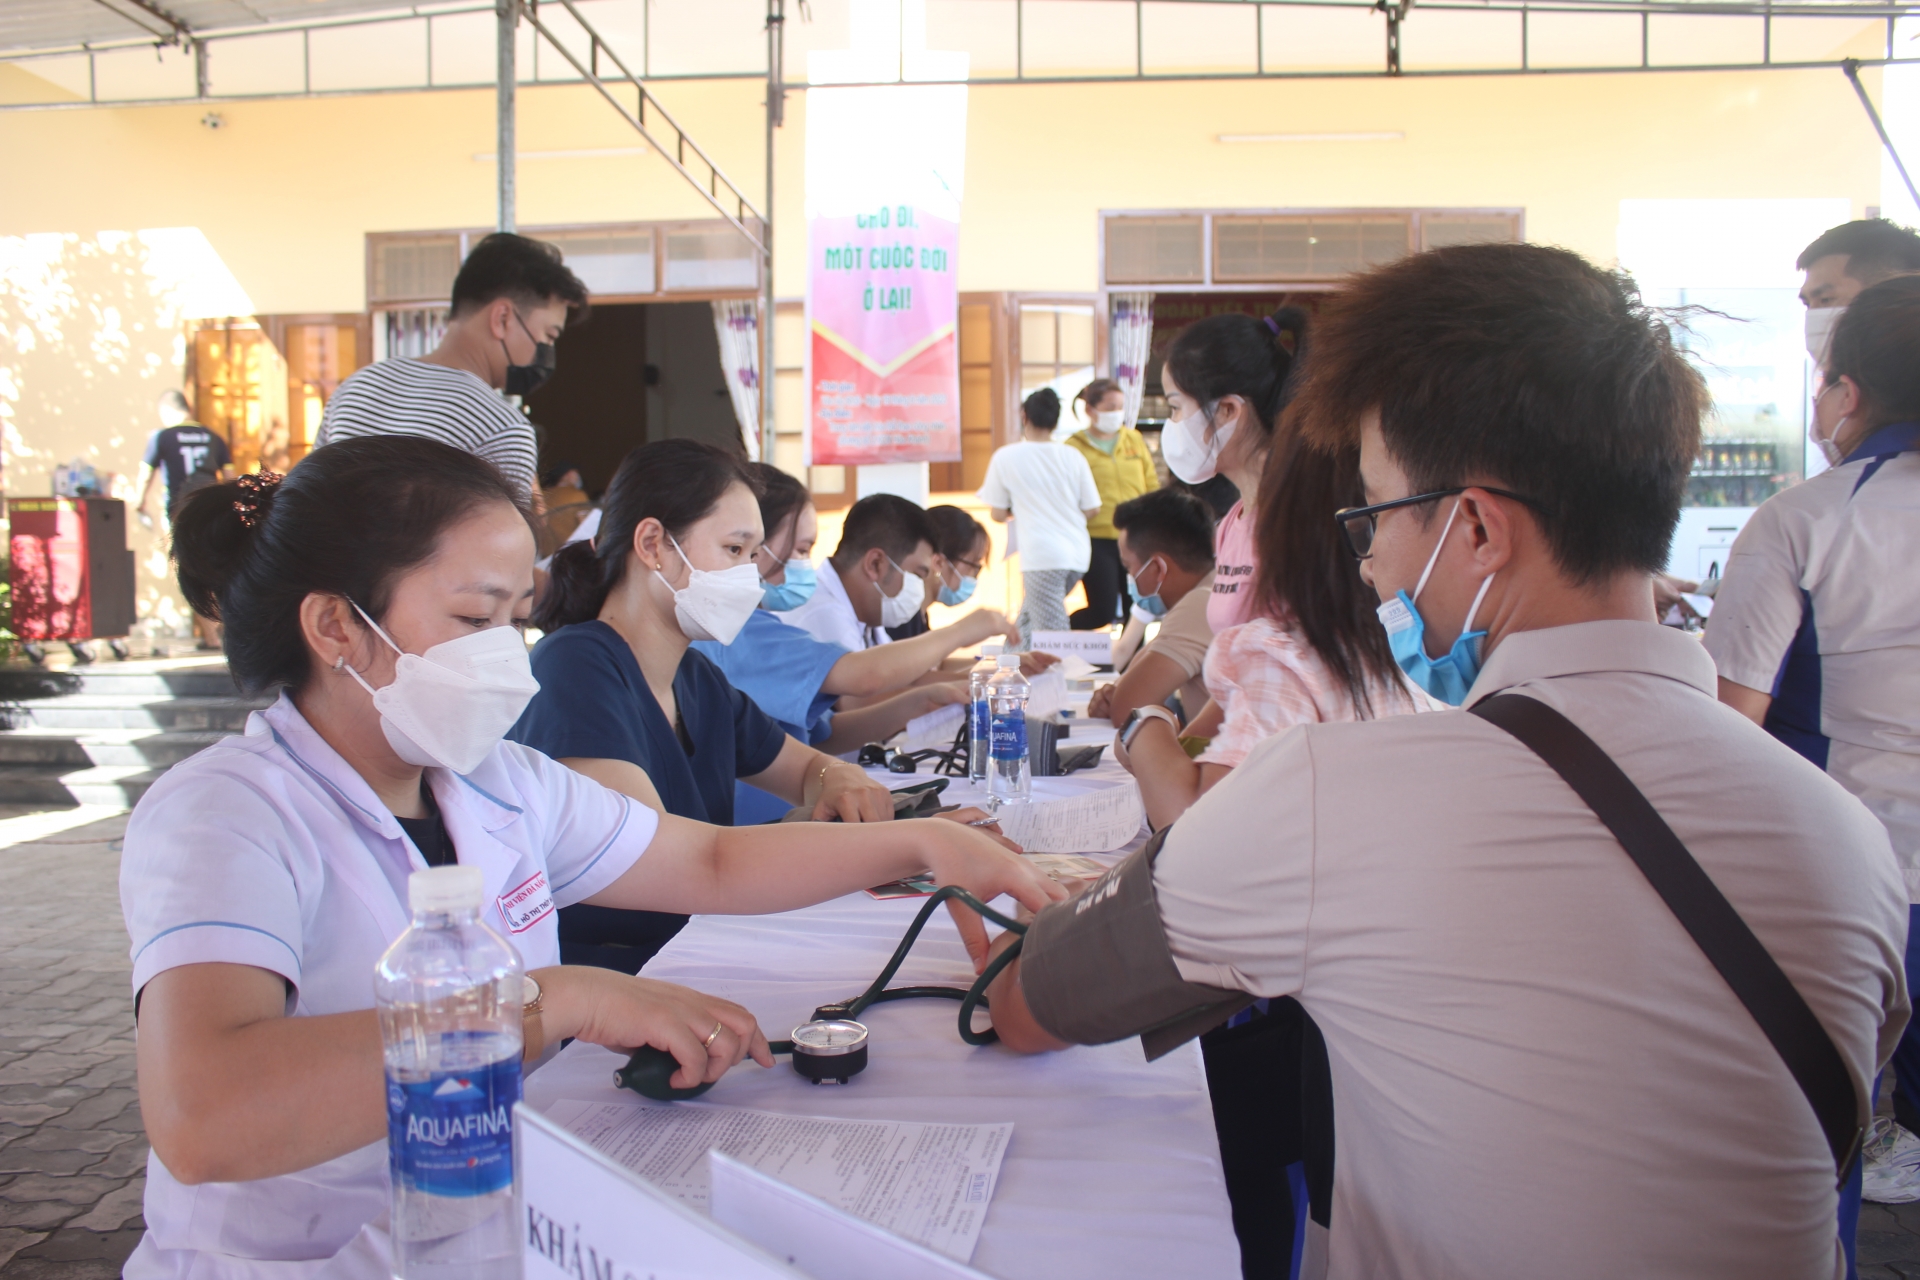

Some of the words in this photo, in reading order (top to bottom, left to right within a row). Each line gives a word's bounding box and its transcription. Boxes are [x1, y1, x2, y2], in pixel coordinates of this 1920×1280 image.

[825, 242, 863, 276] MỘT
[869, 241, 914, 275] CUỘC
[879, 286, 912, 317] LẠI!
[406, 1104, 511, 1146] AQUAFINA
